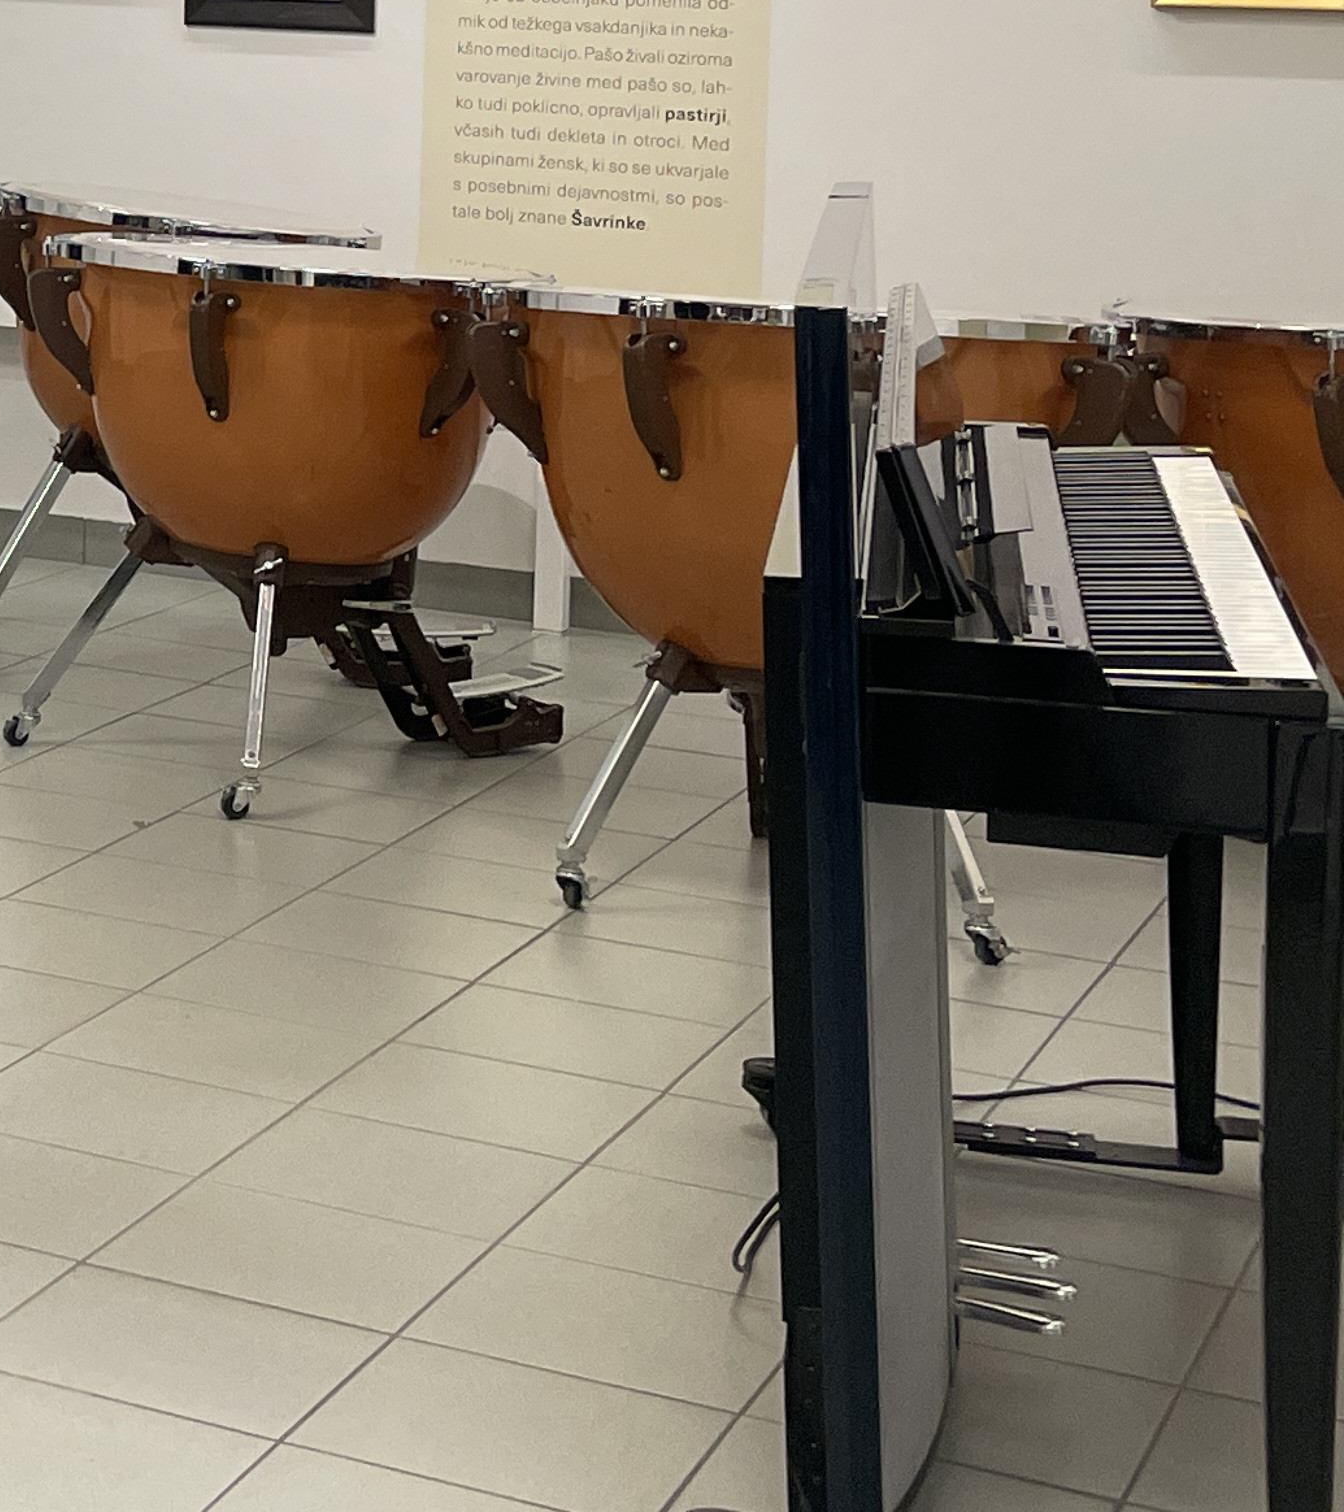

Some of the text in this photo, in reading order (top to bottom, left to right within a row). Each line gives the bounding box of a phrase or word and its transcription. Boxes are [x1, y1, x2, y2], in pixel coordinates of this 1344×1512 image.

[458, 14, 733, 38] mik od težkega vsakdanjika in neka-
[458, 41, 493, 56] kšno
[584, 46, 624, 62] Pašo
[625, 48, 664, 64] živali
[667, 51, 732, 67] oziroma
[456, 72, 531, 88] varovanje
[535, 72, 581, 88] živine
[586, 75, 622, 90] med
[628, 77, 667, 93] pašo
[701, 79, 732, 94] lah-
[456, 96, 473, 110] ko
[478, 97, 507, 111] tudi
[587, 104, 660, 121] opravljali
[454, 123, 504, 139] včasih
[511, 127, 541, 141] tudi
[547, 127, 605, 145] dekleta
[612, 131, 627, 145] in
[692, 135, 730, 151] Med
[454, 151, 534, 168] skupinami
[592, 158, 605, 172] ki
[608, 162, 628, 174] so
[632, 163, 651, 175] se
[655, 162, 729, 182] ukvarjale
[453, 180, 461, 191] s
[468, 180, 551, 197] posebnimi
[666, 193, 686, 205] so
[692, 195, 728, 209] pos-
[452, 205, 481, 219] tale
[485, 206, 514, 225] bolj
[518, 211, 567, 225] znane
